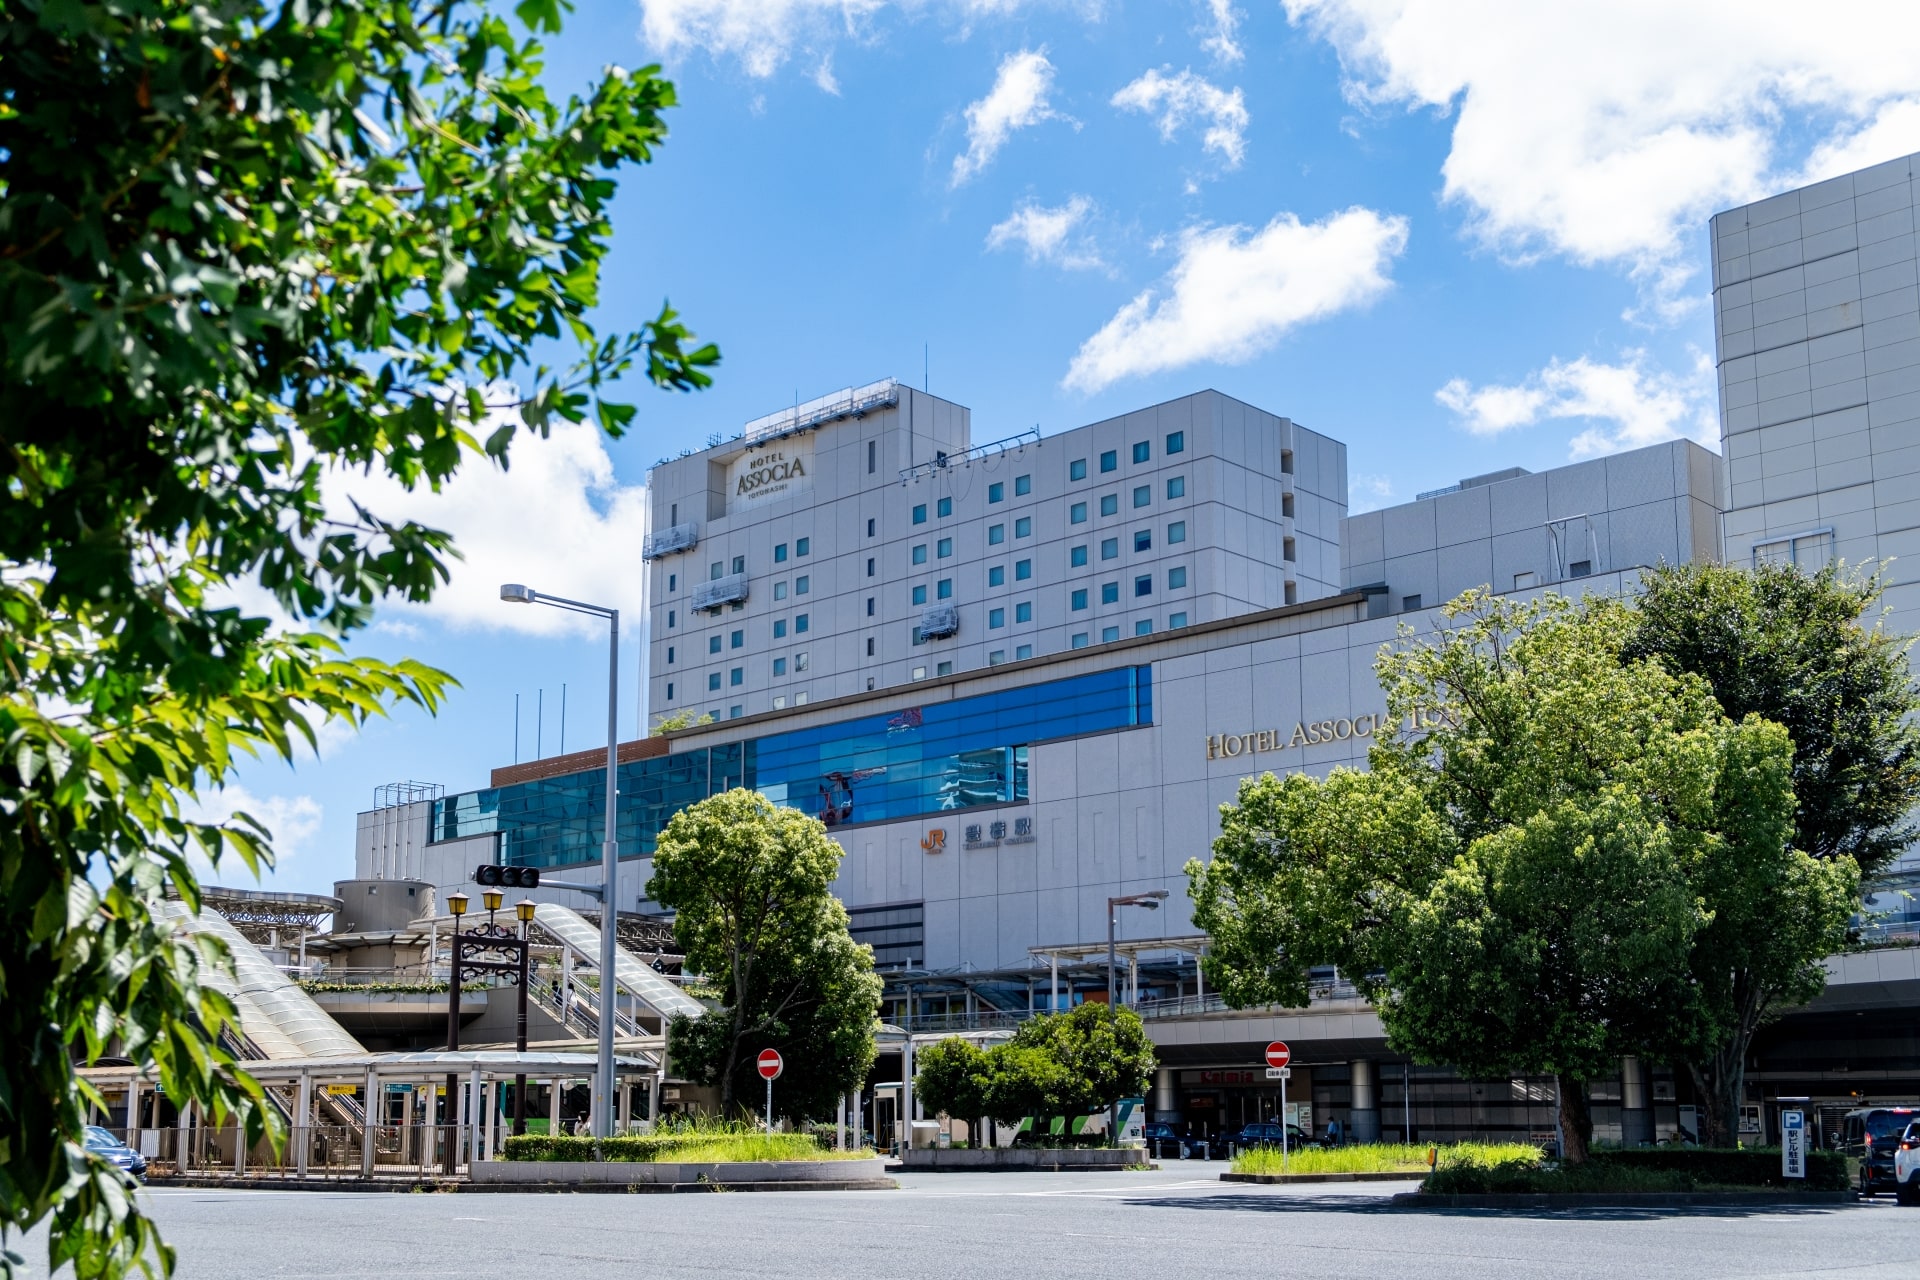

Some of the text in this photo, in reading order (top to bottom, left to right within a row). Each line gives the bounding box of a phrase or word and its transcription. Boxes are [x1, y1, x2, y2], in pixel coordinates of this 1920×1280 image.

[750, 452, 784, 469] HOTEL
[736, 457, 805, 496] ASSOCIA
[748, 484, 788, 500] TOYOHASHI
[1206, 729, 1283, 760] HOTEL
[920, 828, 946, 849] JR
[1785, 1112, 1800, 1127] P
[1788, 1130, 1799, 1173] 駅ビル駐車場
